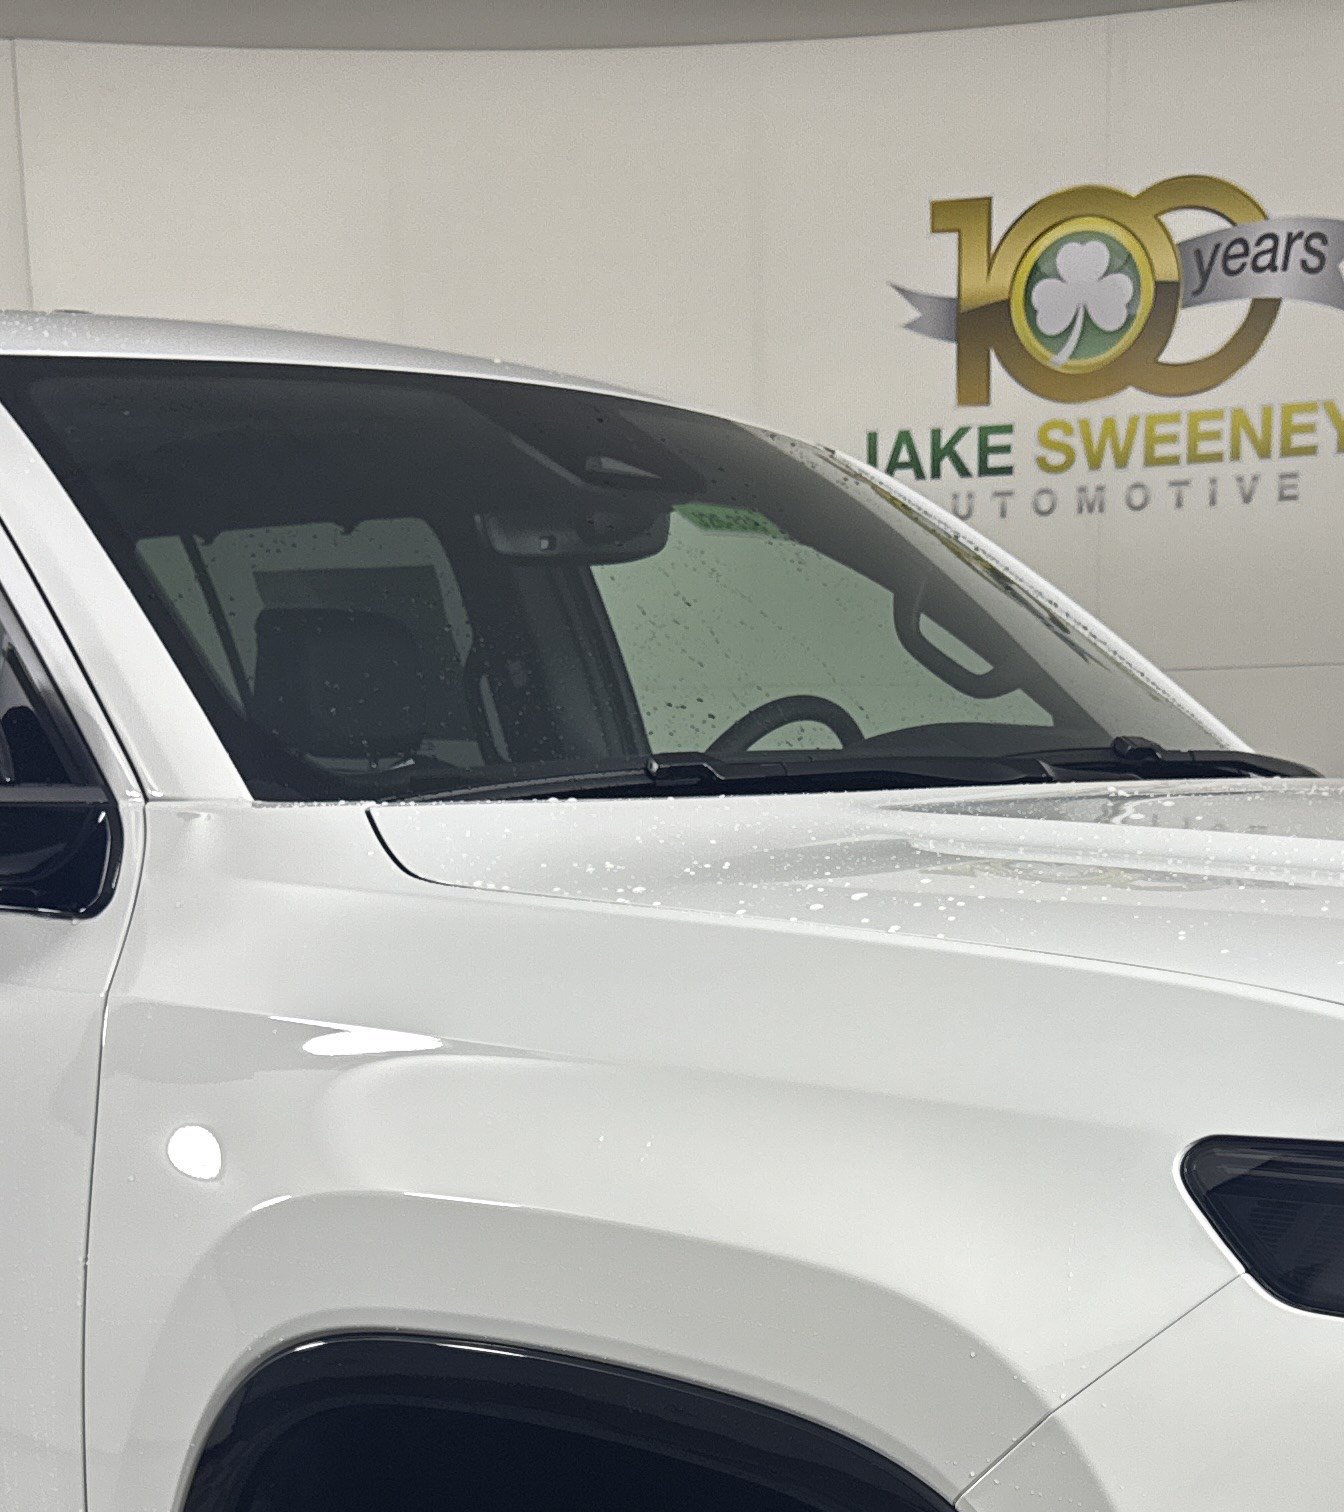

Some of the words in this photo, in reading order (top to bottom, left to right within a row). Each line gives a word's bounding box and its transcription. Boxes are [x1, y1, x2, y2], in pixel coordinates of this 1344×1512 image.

[929, 174, 1283, 407] 100
[1189, 227, 1329, 298] years
[951, 471, 1302, 521] UTOMOTIVE
